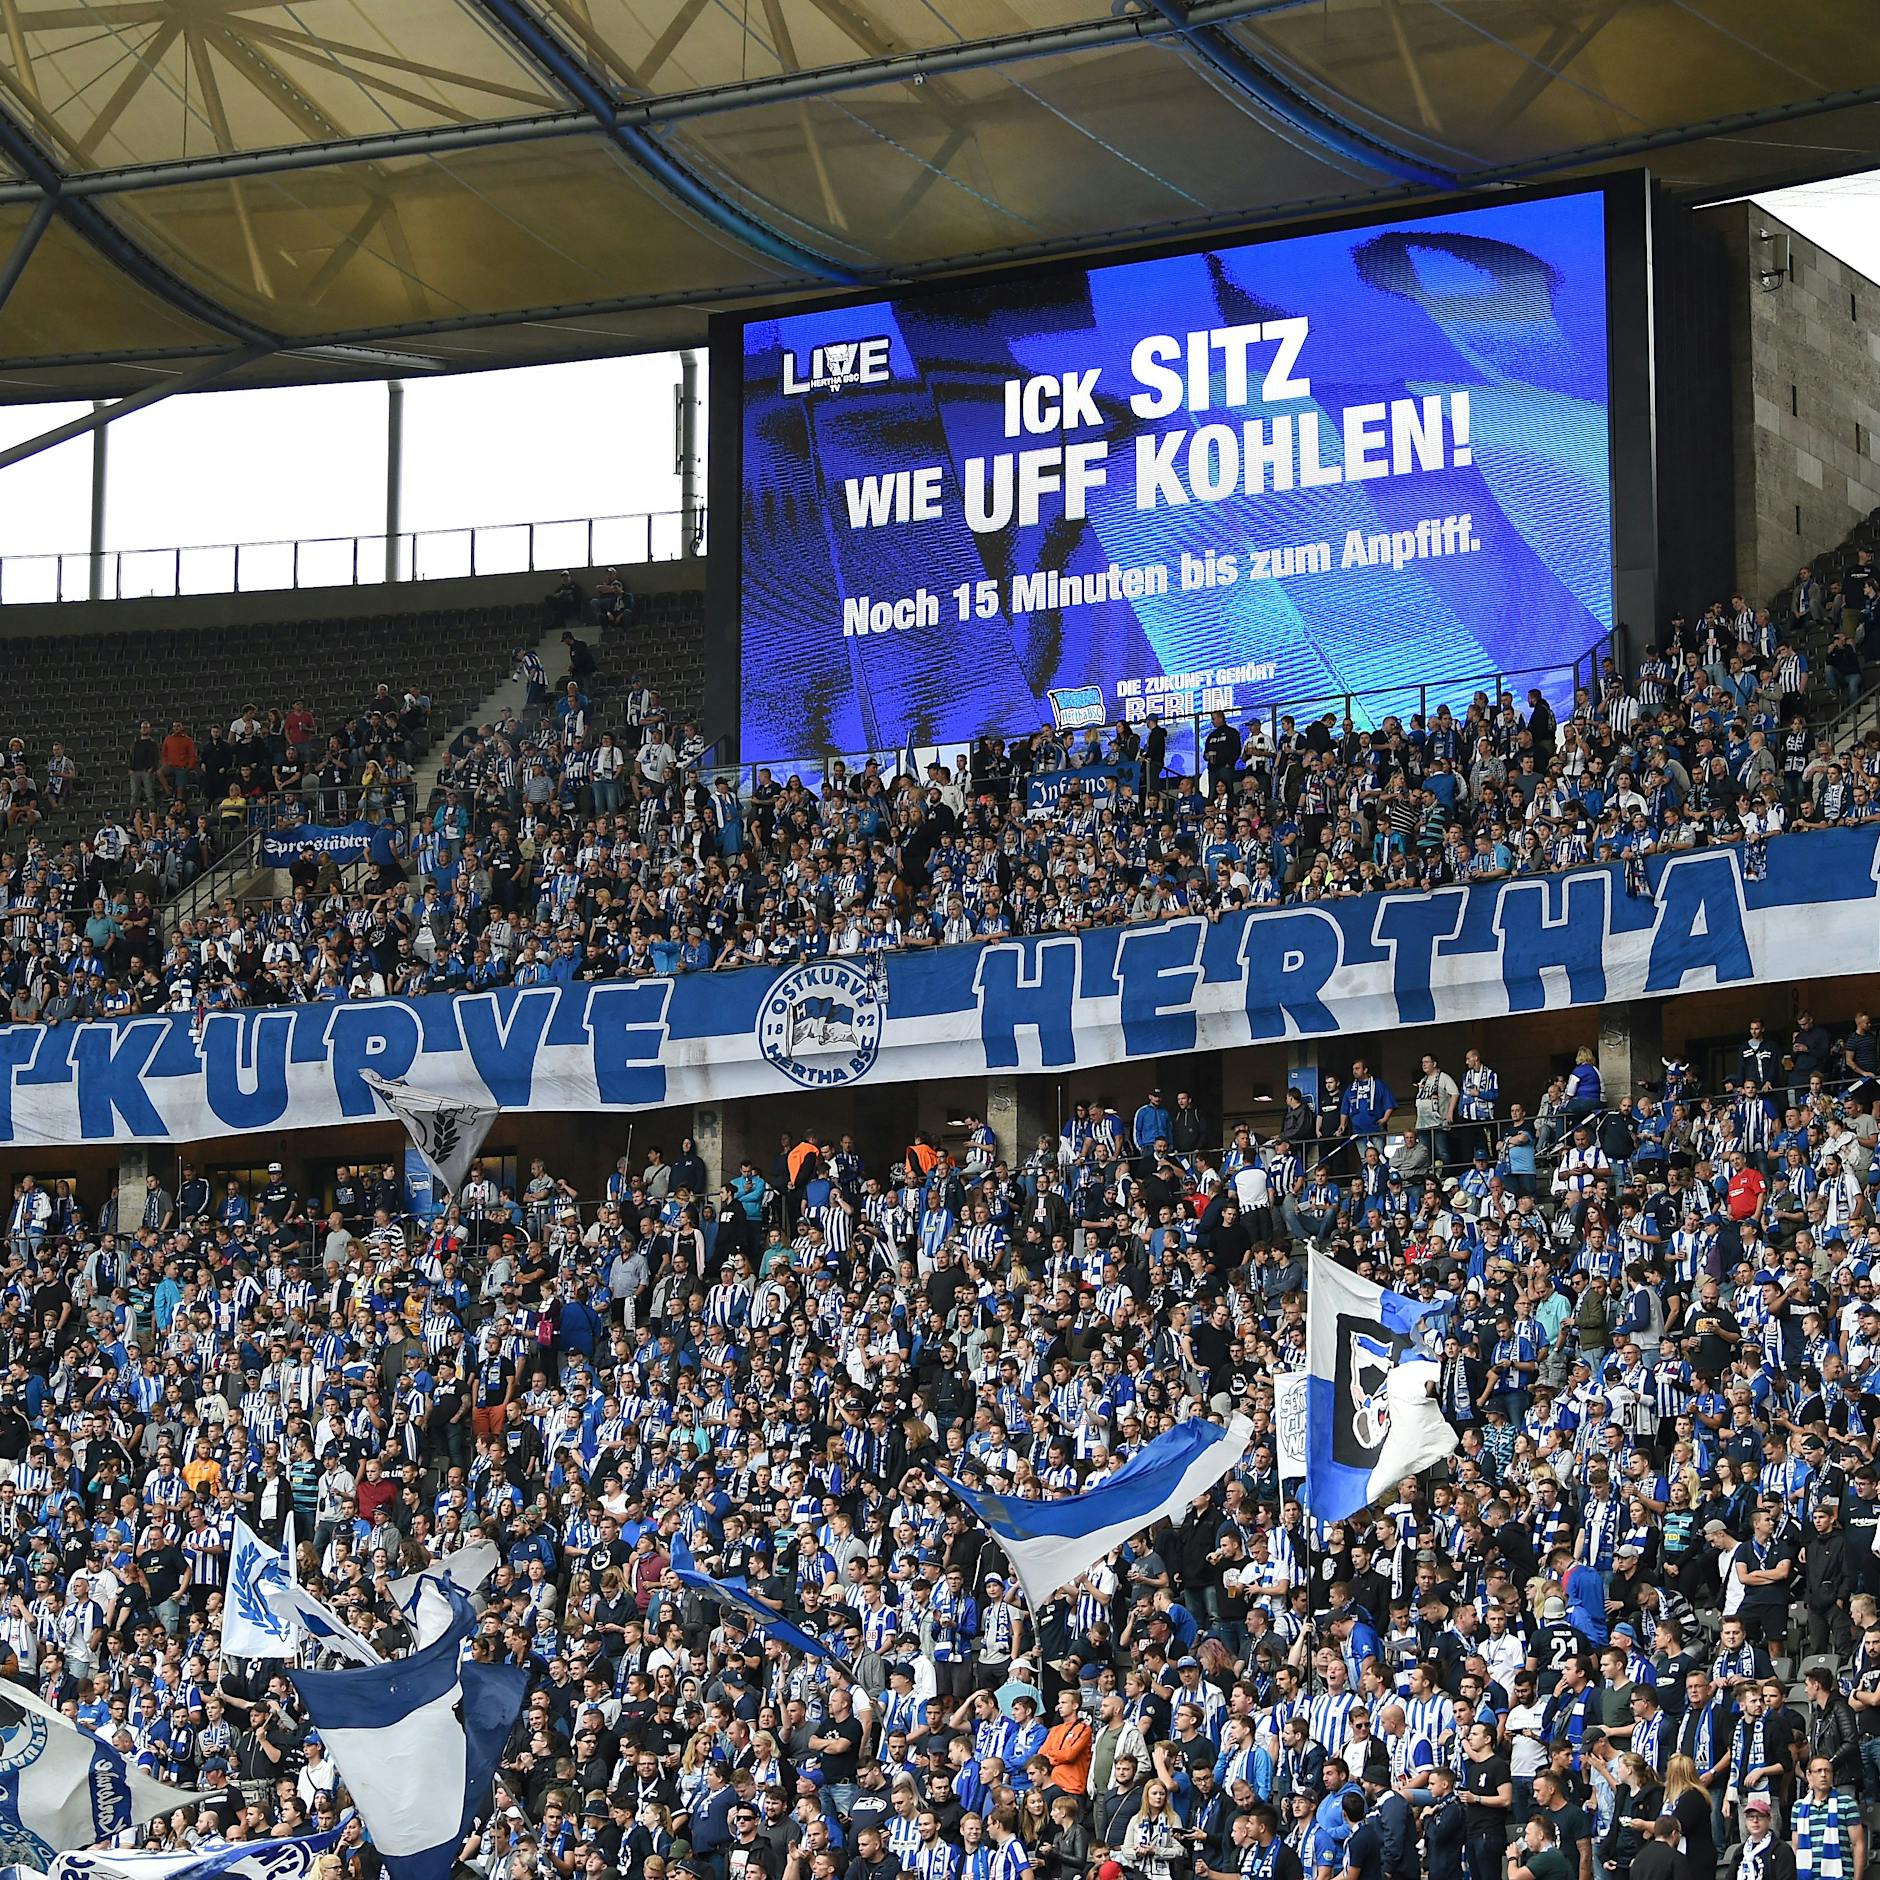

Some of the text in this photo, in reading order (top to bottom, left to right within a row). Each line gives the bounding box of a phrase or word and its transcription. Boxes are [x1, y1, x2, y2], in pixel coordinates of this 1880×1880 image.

[783, 339, 889, 395] LIVE
[811, 373, 859, 388] HERTHA BSC
[830, 384, 840, 392] TV
[1004, 316, 1310, 438] ICK SITZ
[844, 391, 1472, 533] WIE UFF KOHLEN!
[843, 514, 1480, 637] Noch 15 Minuten bis zum Anpfiff.
[1117, 661, 1277, 697] DIE ZUKUNFT GEHÖRT
[973, 848, 1756, 1068] HERTHA
[767, 1014, 875, 1035] 18 92
[767, 1035, 874, 1083] HERTHA BSC
[699, 1111, 718, 1139] R
[1551, 1637, 1578, 1669] 21
